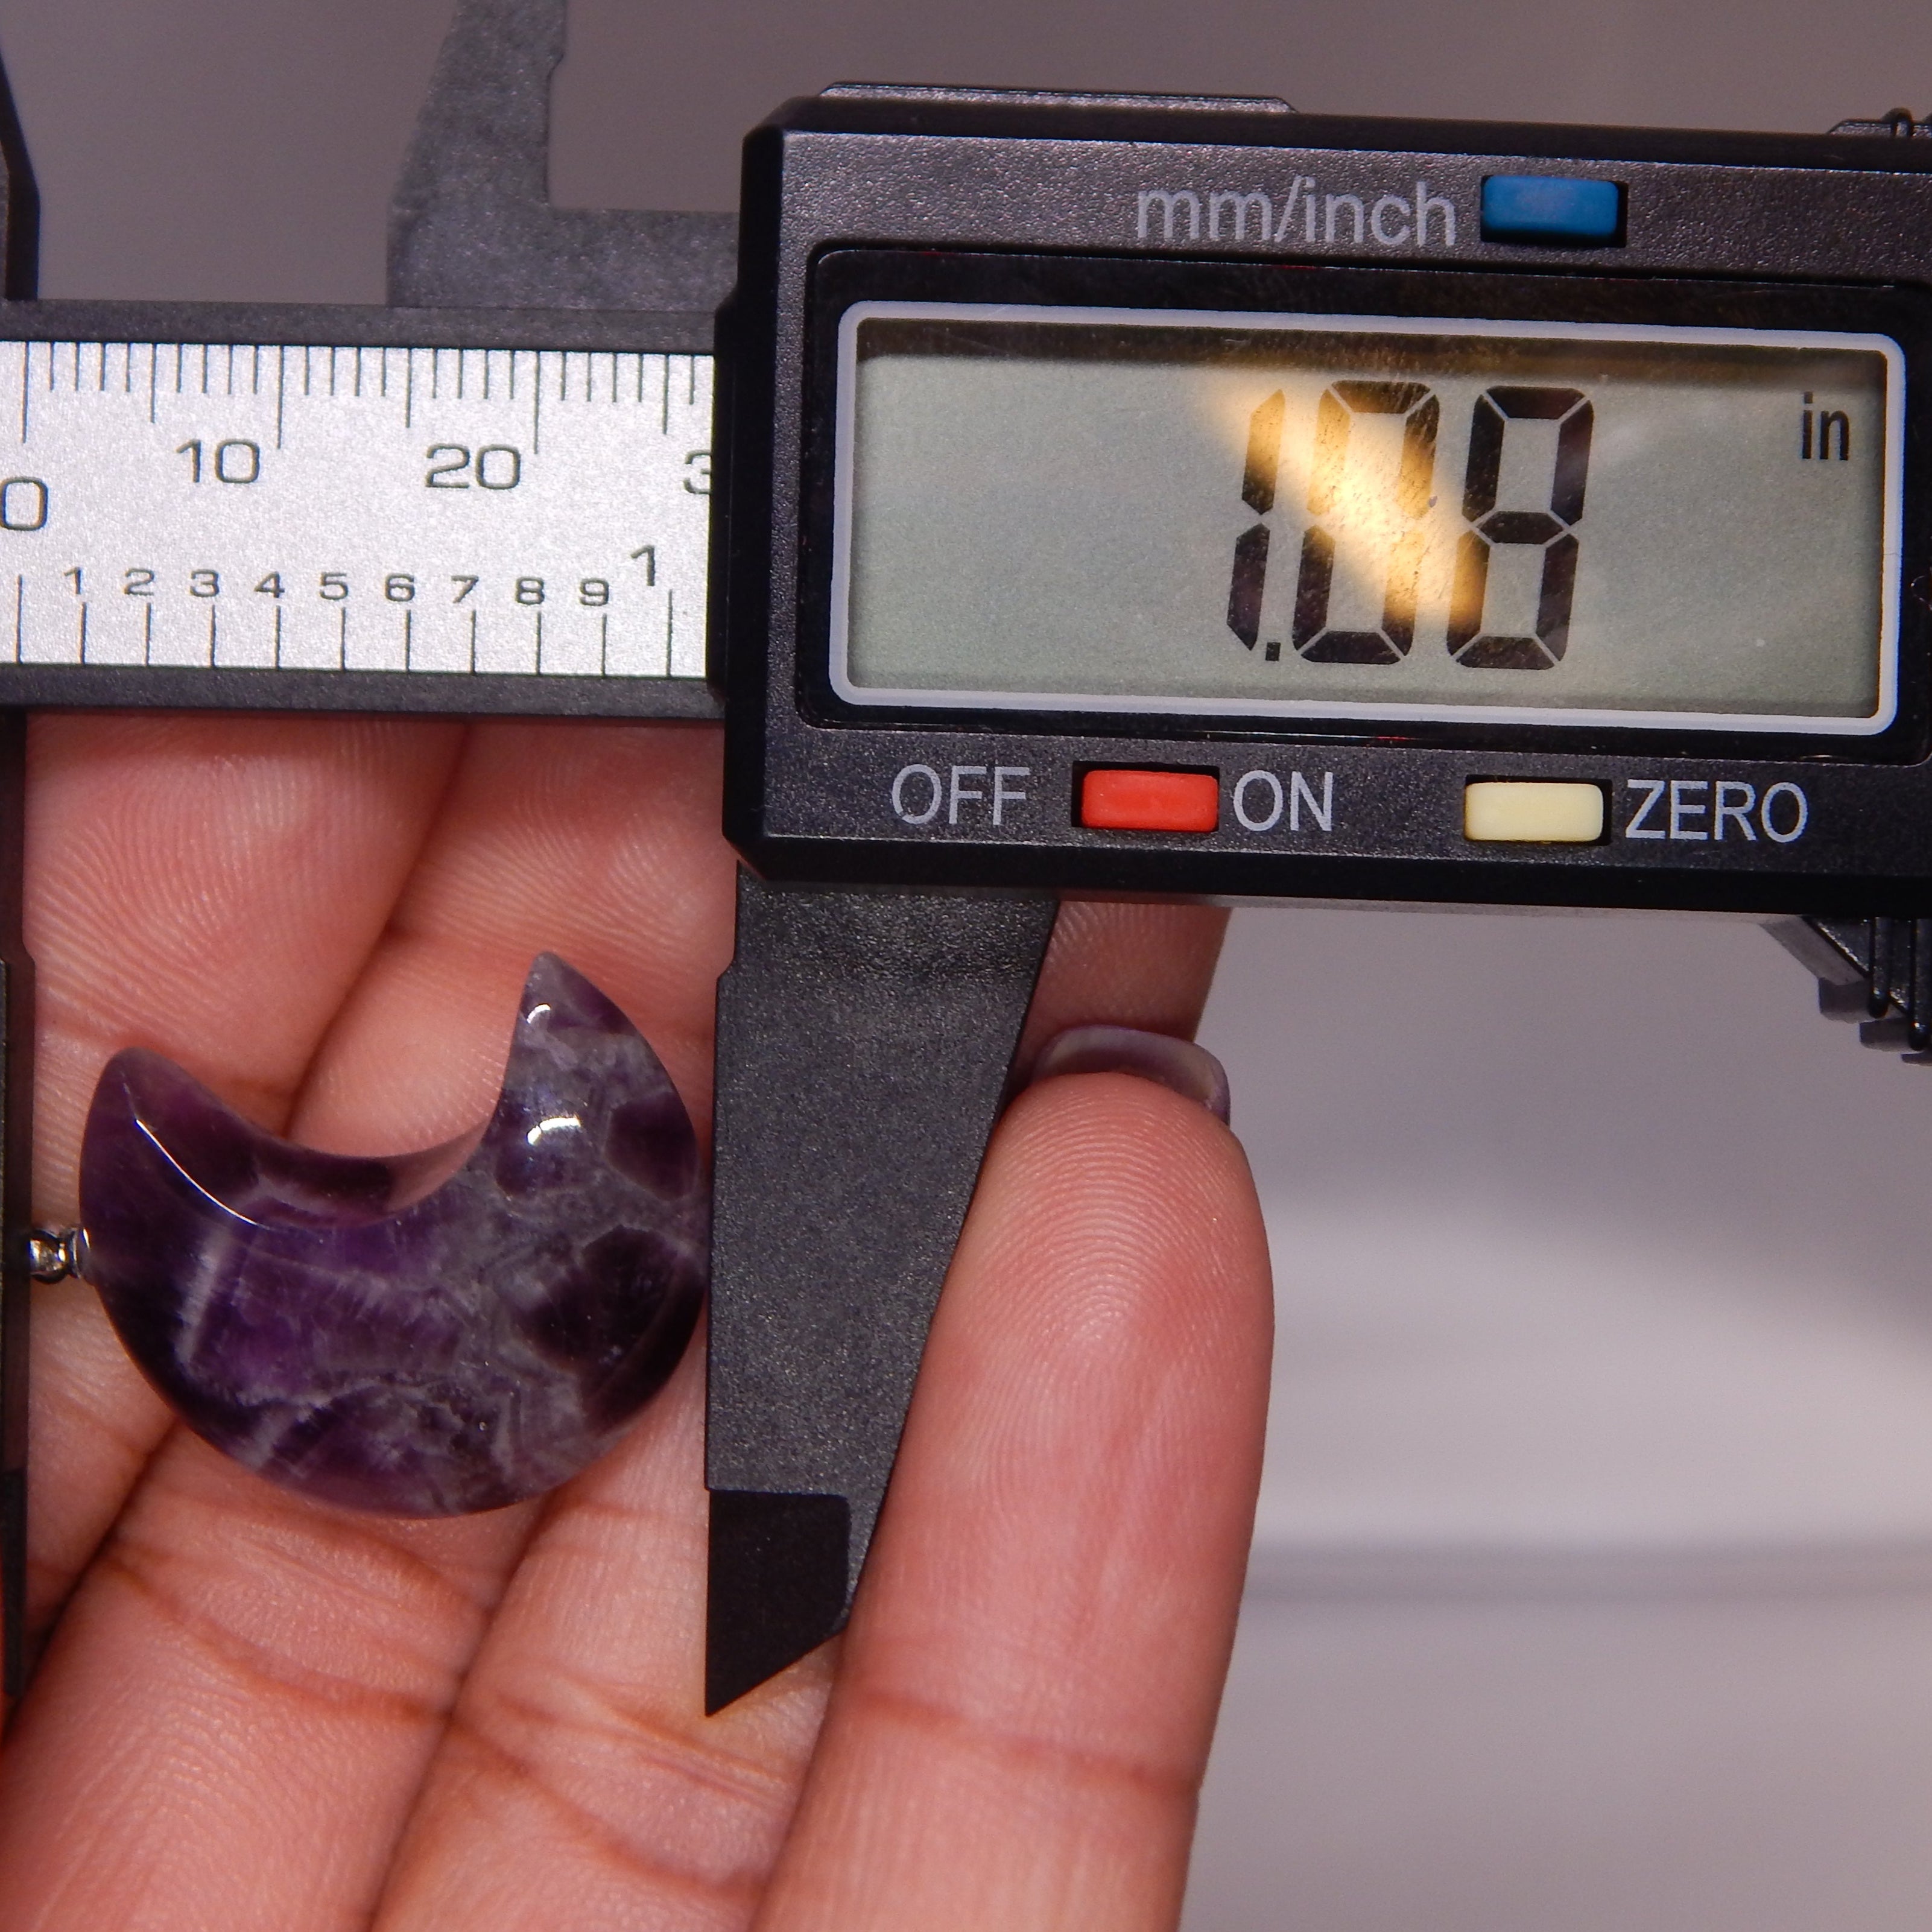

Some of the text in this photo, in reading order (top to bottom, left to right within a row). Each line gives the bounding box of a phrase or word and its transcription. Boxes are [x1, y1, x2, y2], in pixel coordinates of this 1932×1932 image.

[1138, 175, 1457, 247] mm/inch
[1802, 391, 1849, 461] in
[176, 439, 261, 484] 10
[425, 443, 521, 490] 20
[0, 476, 49, 531] 0
[1226, 380, 1594, 670] 1.08
[63, 544, 656, 606] 1 2 3 4 5 6 7 8 9 1
[890, 764, 1031, 826] OFF
[1233, 769, 1334, 832] ON
[1626, 779, 1809, 843] ZERO
